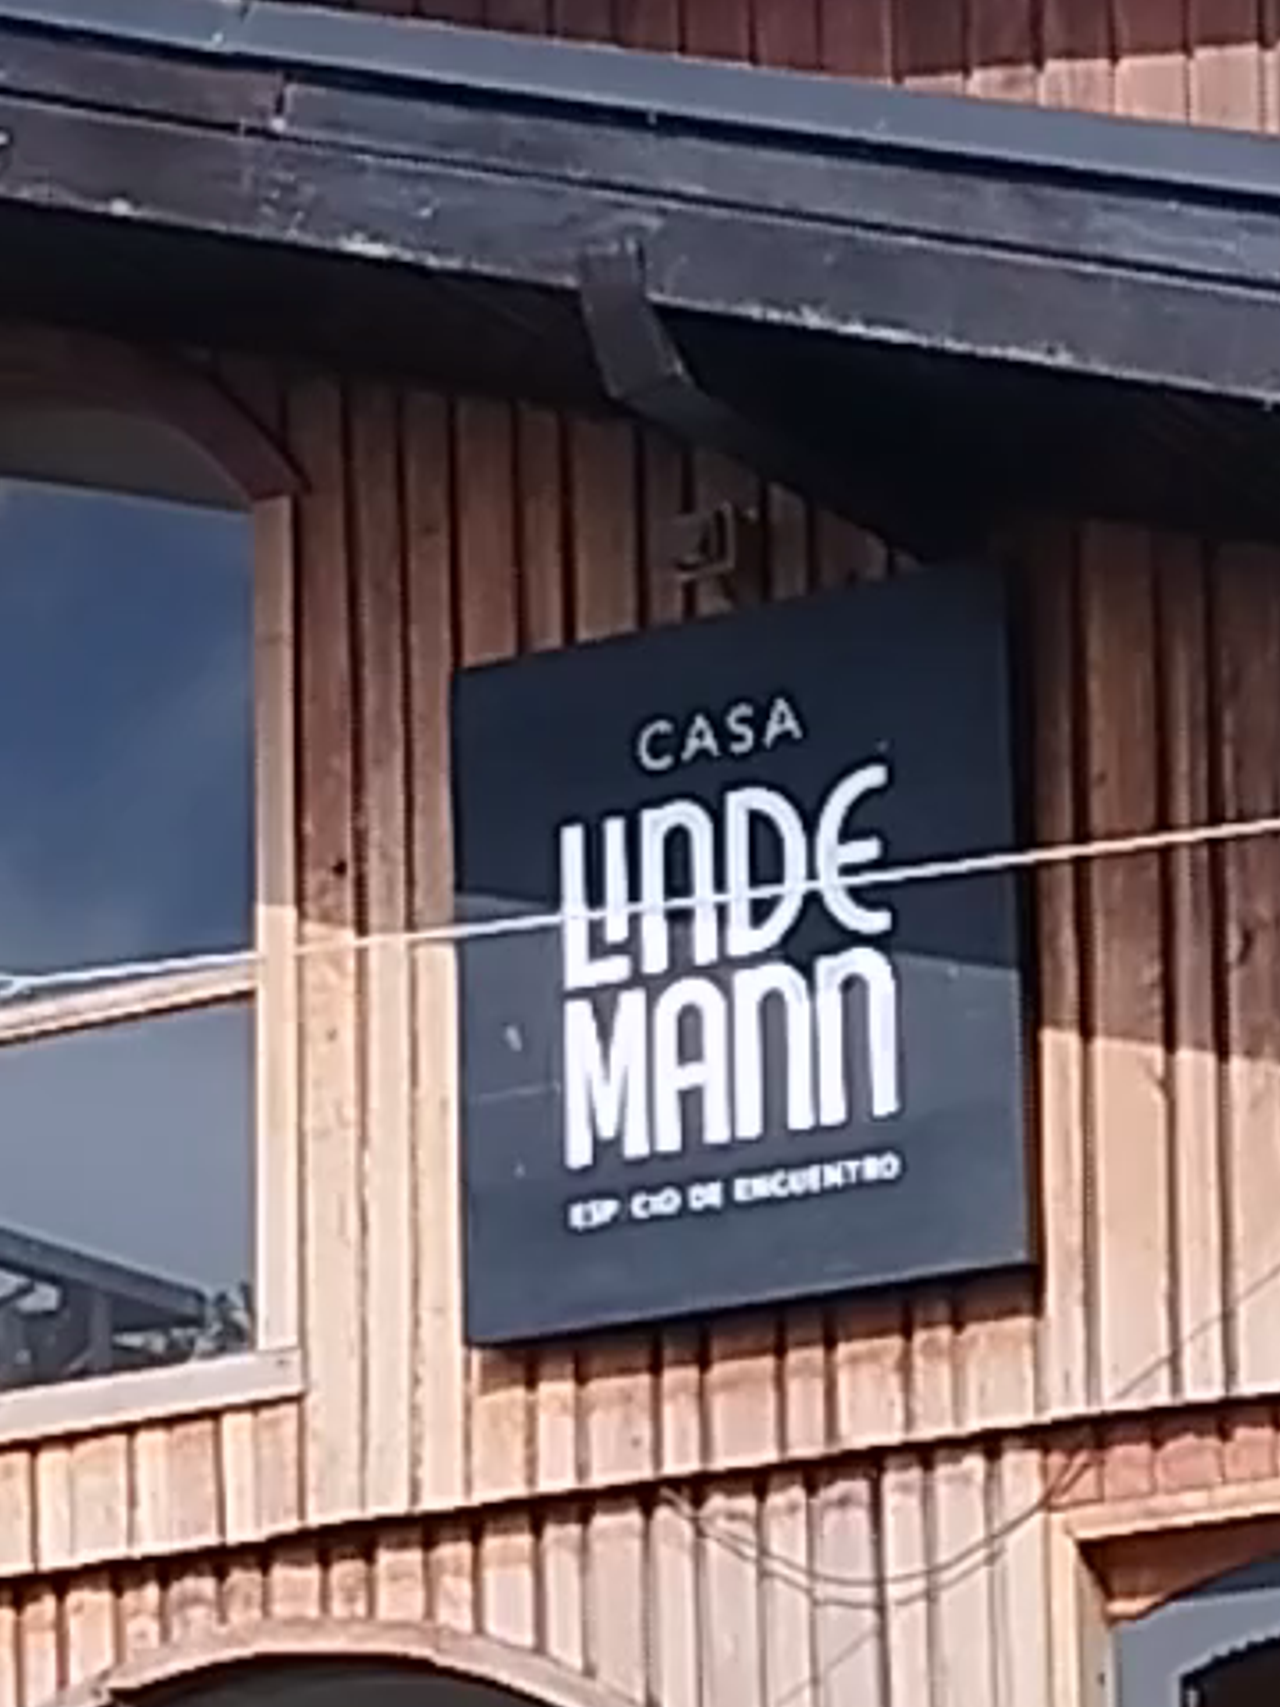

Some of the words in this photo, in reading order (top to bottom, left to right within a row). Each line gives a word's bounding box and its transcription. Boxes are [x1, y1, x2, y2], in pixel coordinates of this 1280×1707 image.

[638, 698, 801, 770] CASA
[559, 764, 893, 991] LINDE
[562, 946, 901, 1171] MANN
[687, 1180, 723, 1212] DE
[733, 1151, 902, 1203] ENCUENTRO
